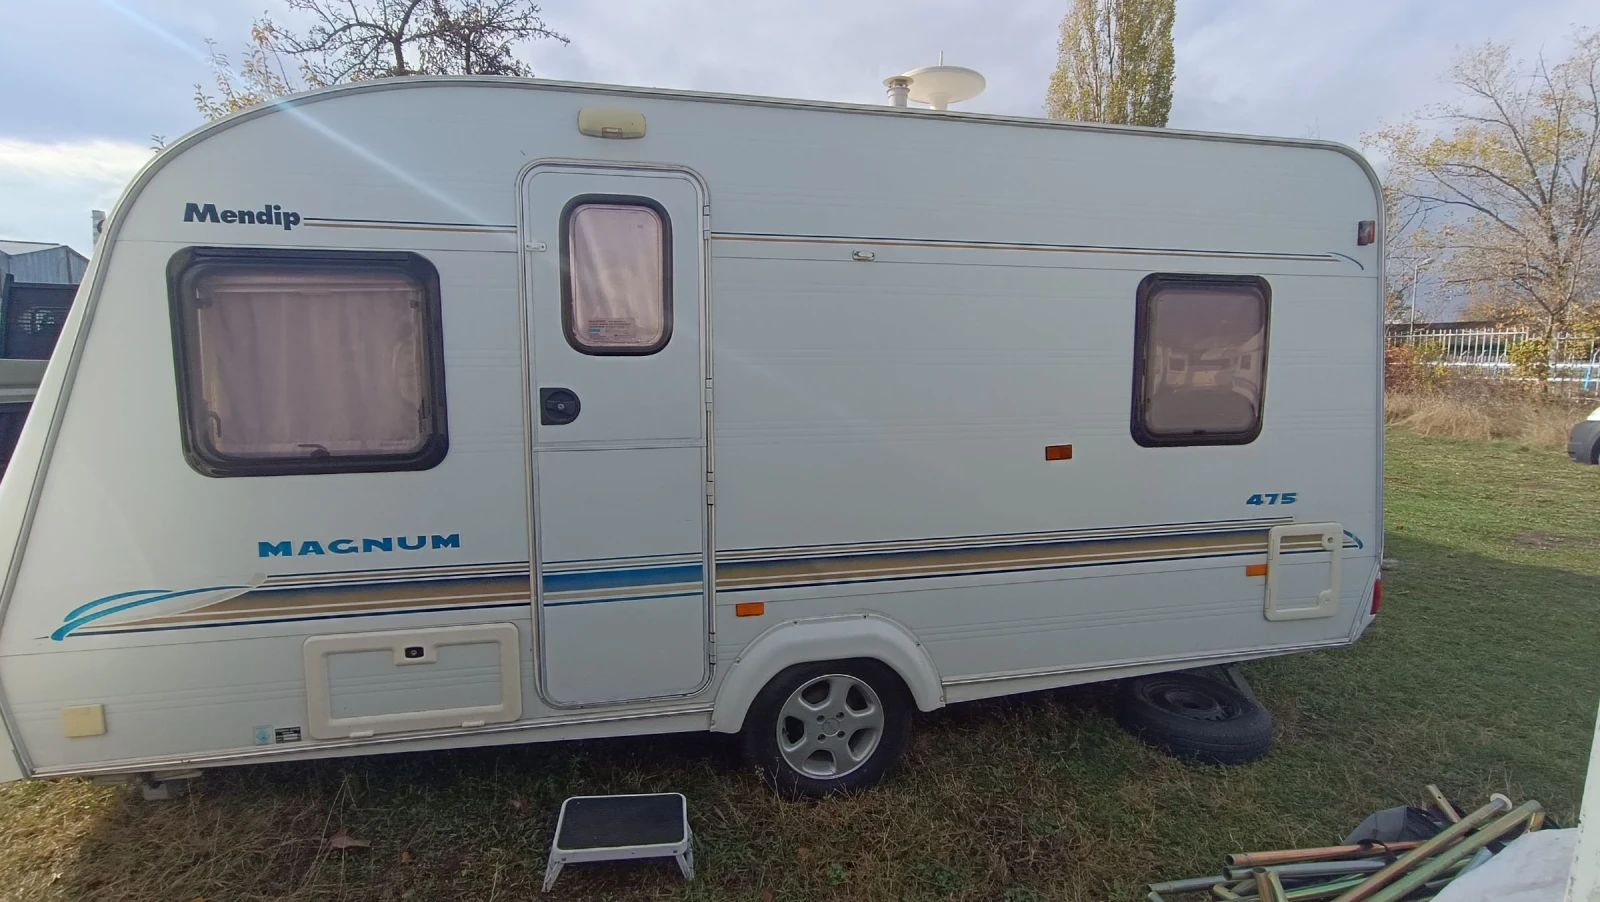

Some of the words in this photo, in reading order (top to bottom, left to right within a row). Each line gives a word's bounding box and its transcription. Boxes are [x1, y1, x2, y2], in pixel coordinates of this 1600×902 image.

[183, 202, 301, 231] Mendip
[1245, 492, 1298, 506] 475
[257, 533, 461, 558] MAGNUM
